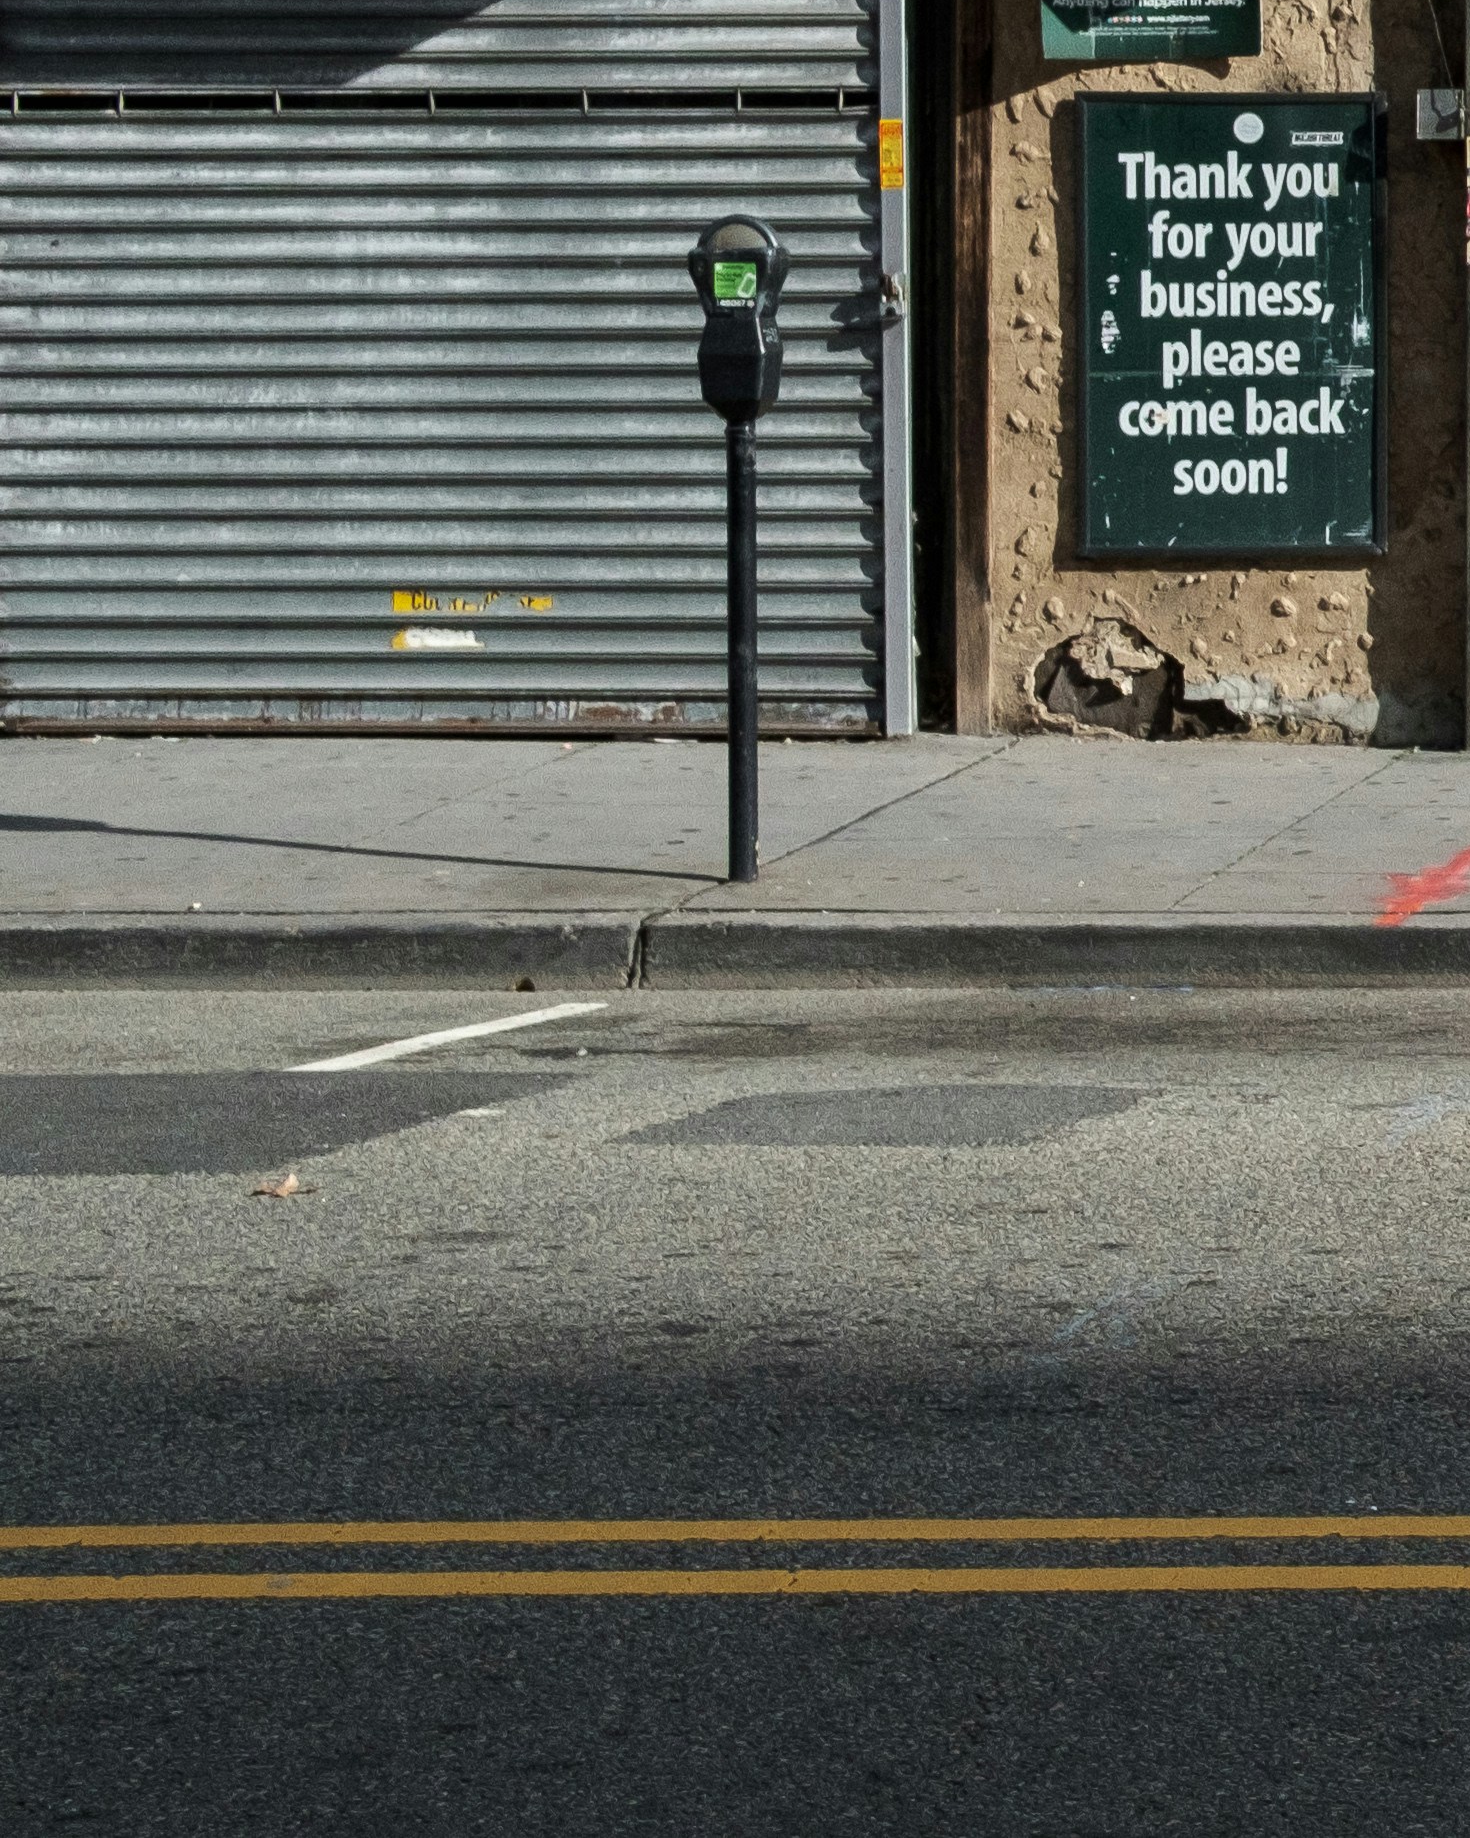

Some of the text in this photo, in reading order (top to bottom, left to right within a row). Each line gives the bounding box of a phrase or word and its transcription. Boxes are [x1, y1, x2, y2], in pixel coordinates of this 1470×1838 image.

[1117, 150, 1340, 211] Thank you
[1147, 210, 1324, 270] for your
[1140, 269, 1335, 323] business,
[1162, 328, 1301, 389] please
[1118, 386, 1346, 437] come back
[1173, 446, 1288, 495] soon!
